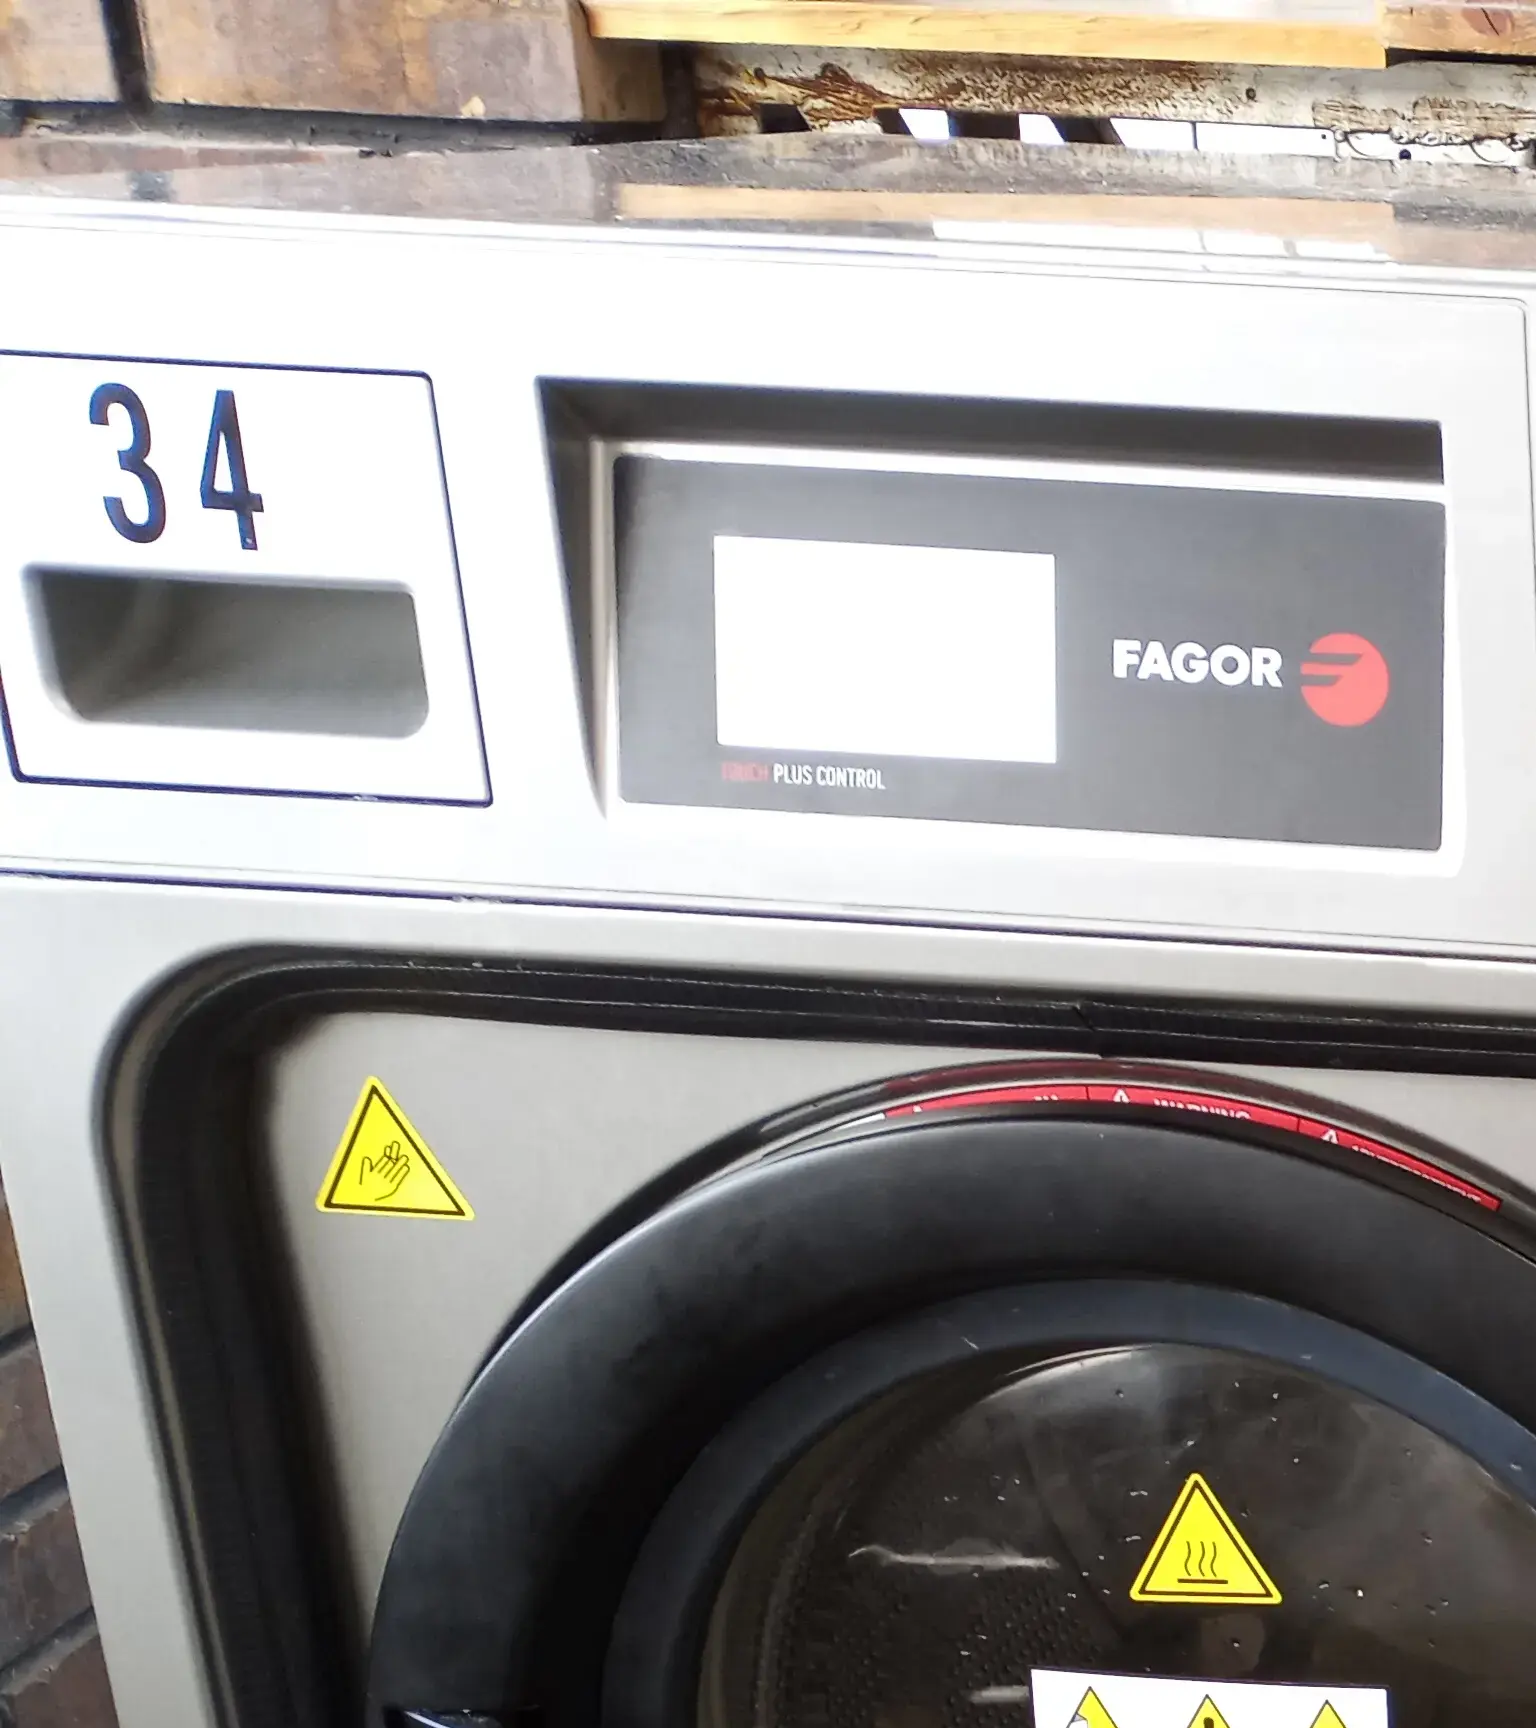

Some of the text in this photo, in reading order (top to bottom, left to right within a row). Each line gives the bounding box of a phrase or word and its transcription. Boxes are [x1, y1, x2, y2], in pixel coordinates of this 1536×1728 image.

[89, 383, 264, 550] 34
[1112, 639, 1283, 688] FAGOR
[773, 763, 813, 786] PLUS
[816, 765, 886, 790] CONTROL
